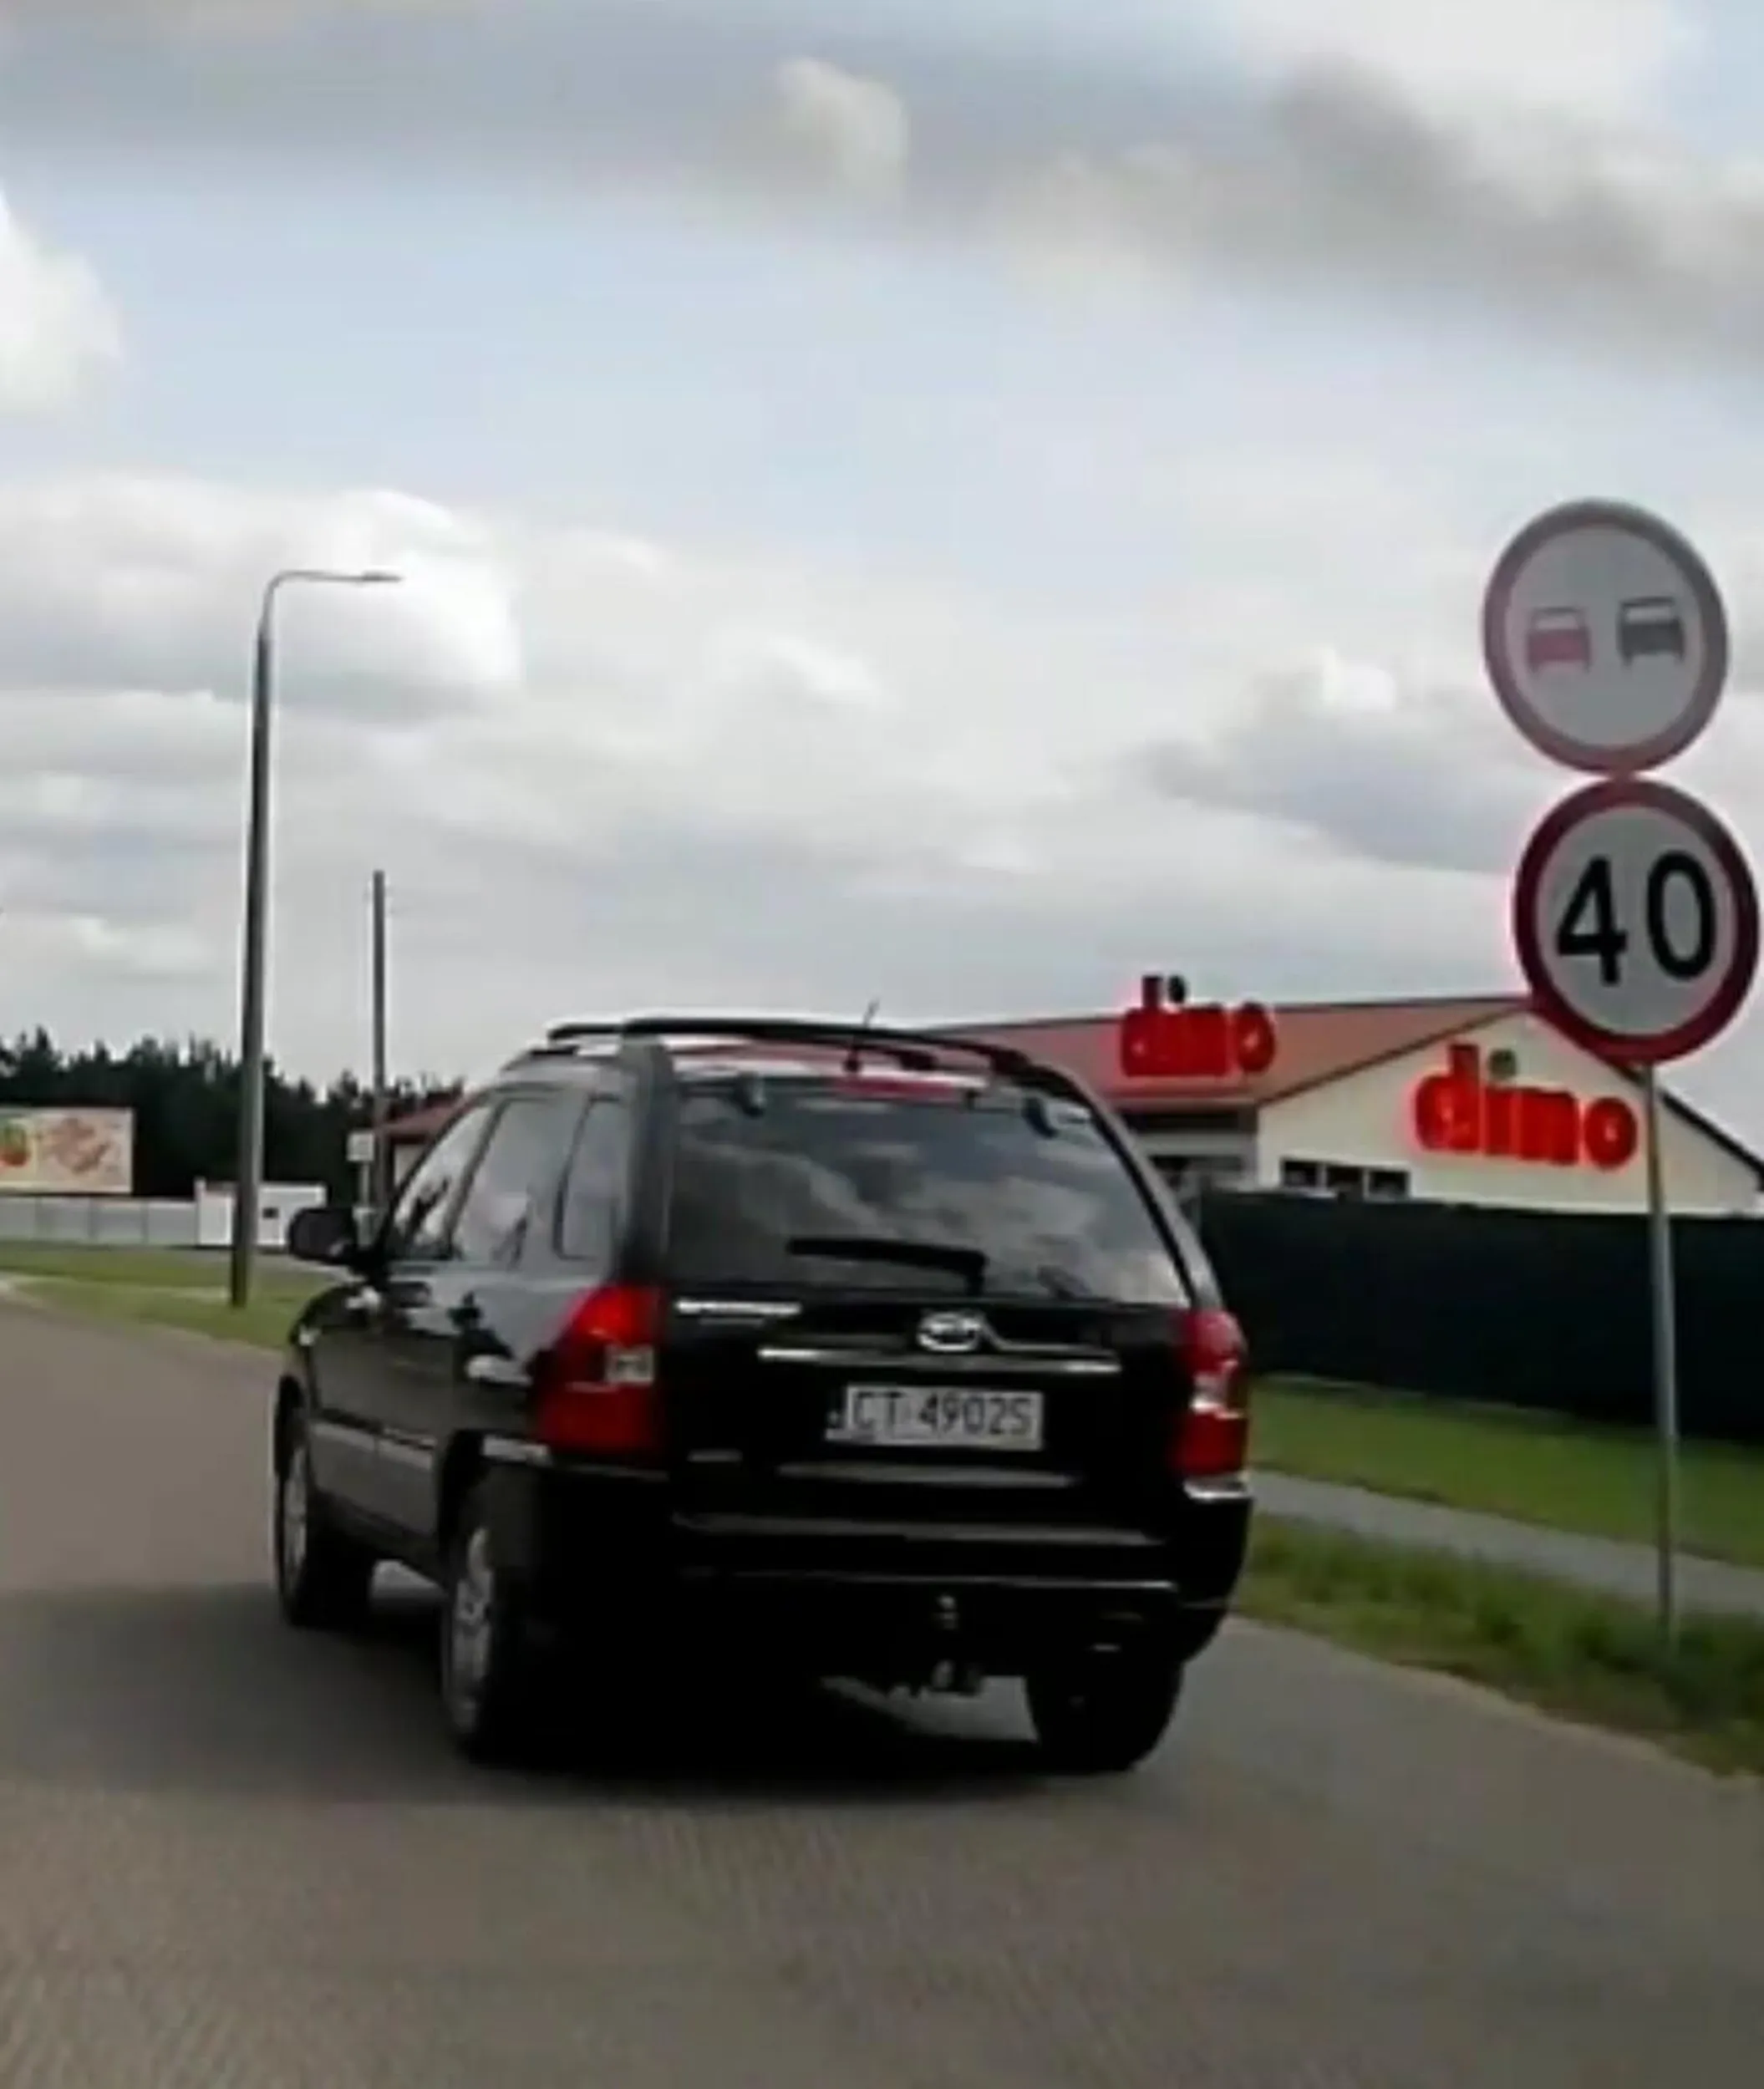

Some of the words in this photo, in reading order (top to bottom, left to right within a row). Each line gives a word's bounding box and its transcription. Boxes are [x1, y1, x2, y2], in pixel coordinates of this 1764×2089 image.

[1554, 851, 1716, 986] 40
[1121, 974, 1274, 1077] dino
[1415, 1044, 1637, 1172] dino
[851, 1390, 906, 1436] CT
